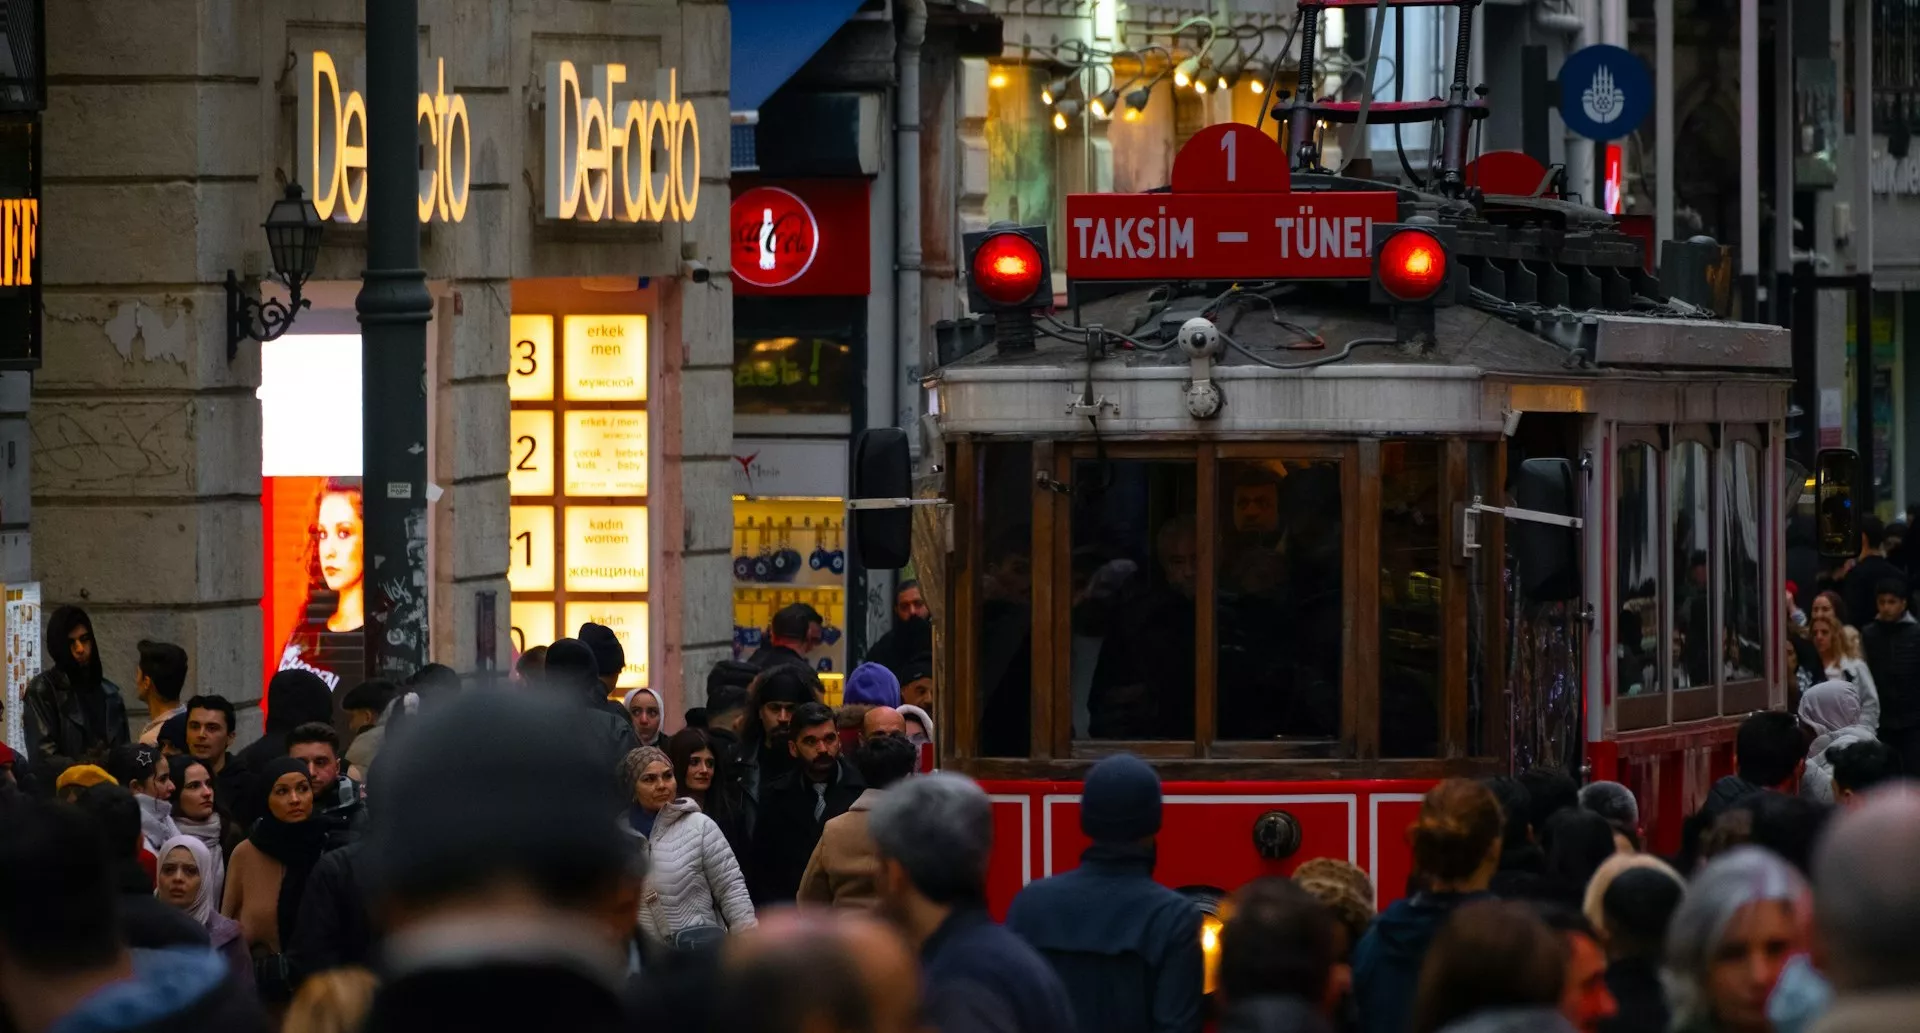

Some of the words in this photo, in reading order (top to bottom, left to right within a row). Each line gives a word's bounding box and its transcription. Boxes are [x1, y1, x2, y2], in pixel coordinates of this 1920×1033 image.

[313, 51, 471, 223] Decto
[559, 60, 701, 223] DeFacto
[1220, 130, 1237, 182] 1
[1073, 205, 1194, 259] TAKSİM
[587, 324, 624, 338] erkek
[516, 340, 537, 376] 3
[591, 344, 621, 356] men
[516, 435, 537, 471] 2
[516, 531, 531, 567] 1
[584, 534, 629, 544] women
